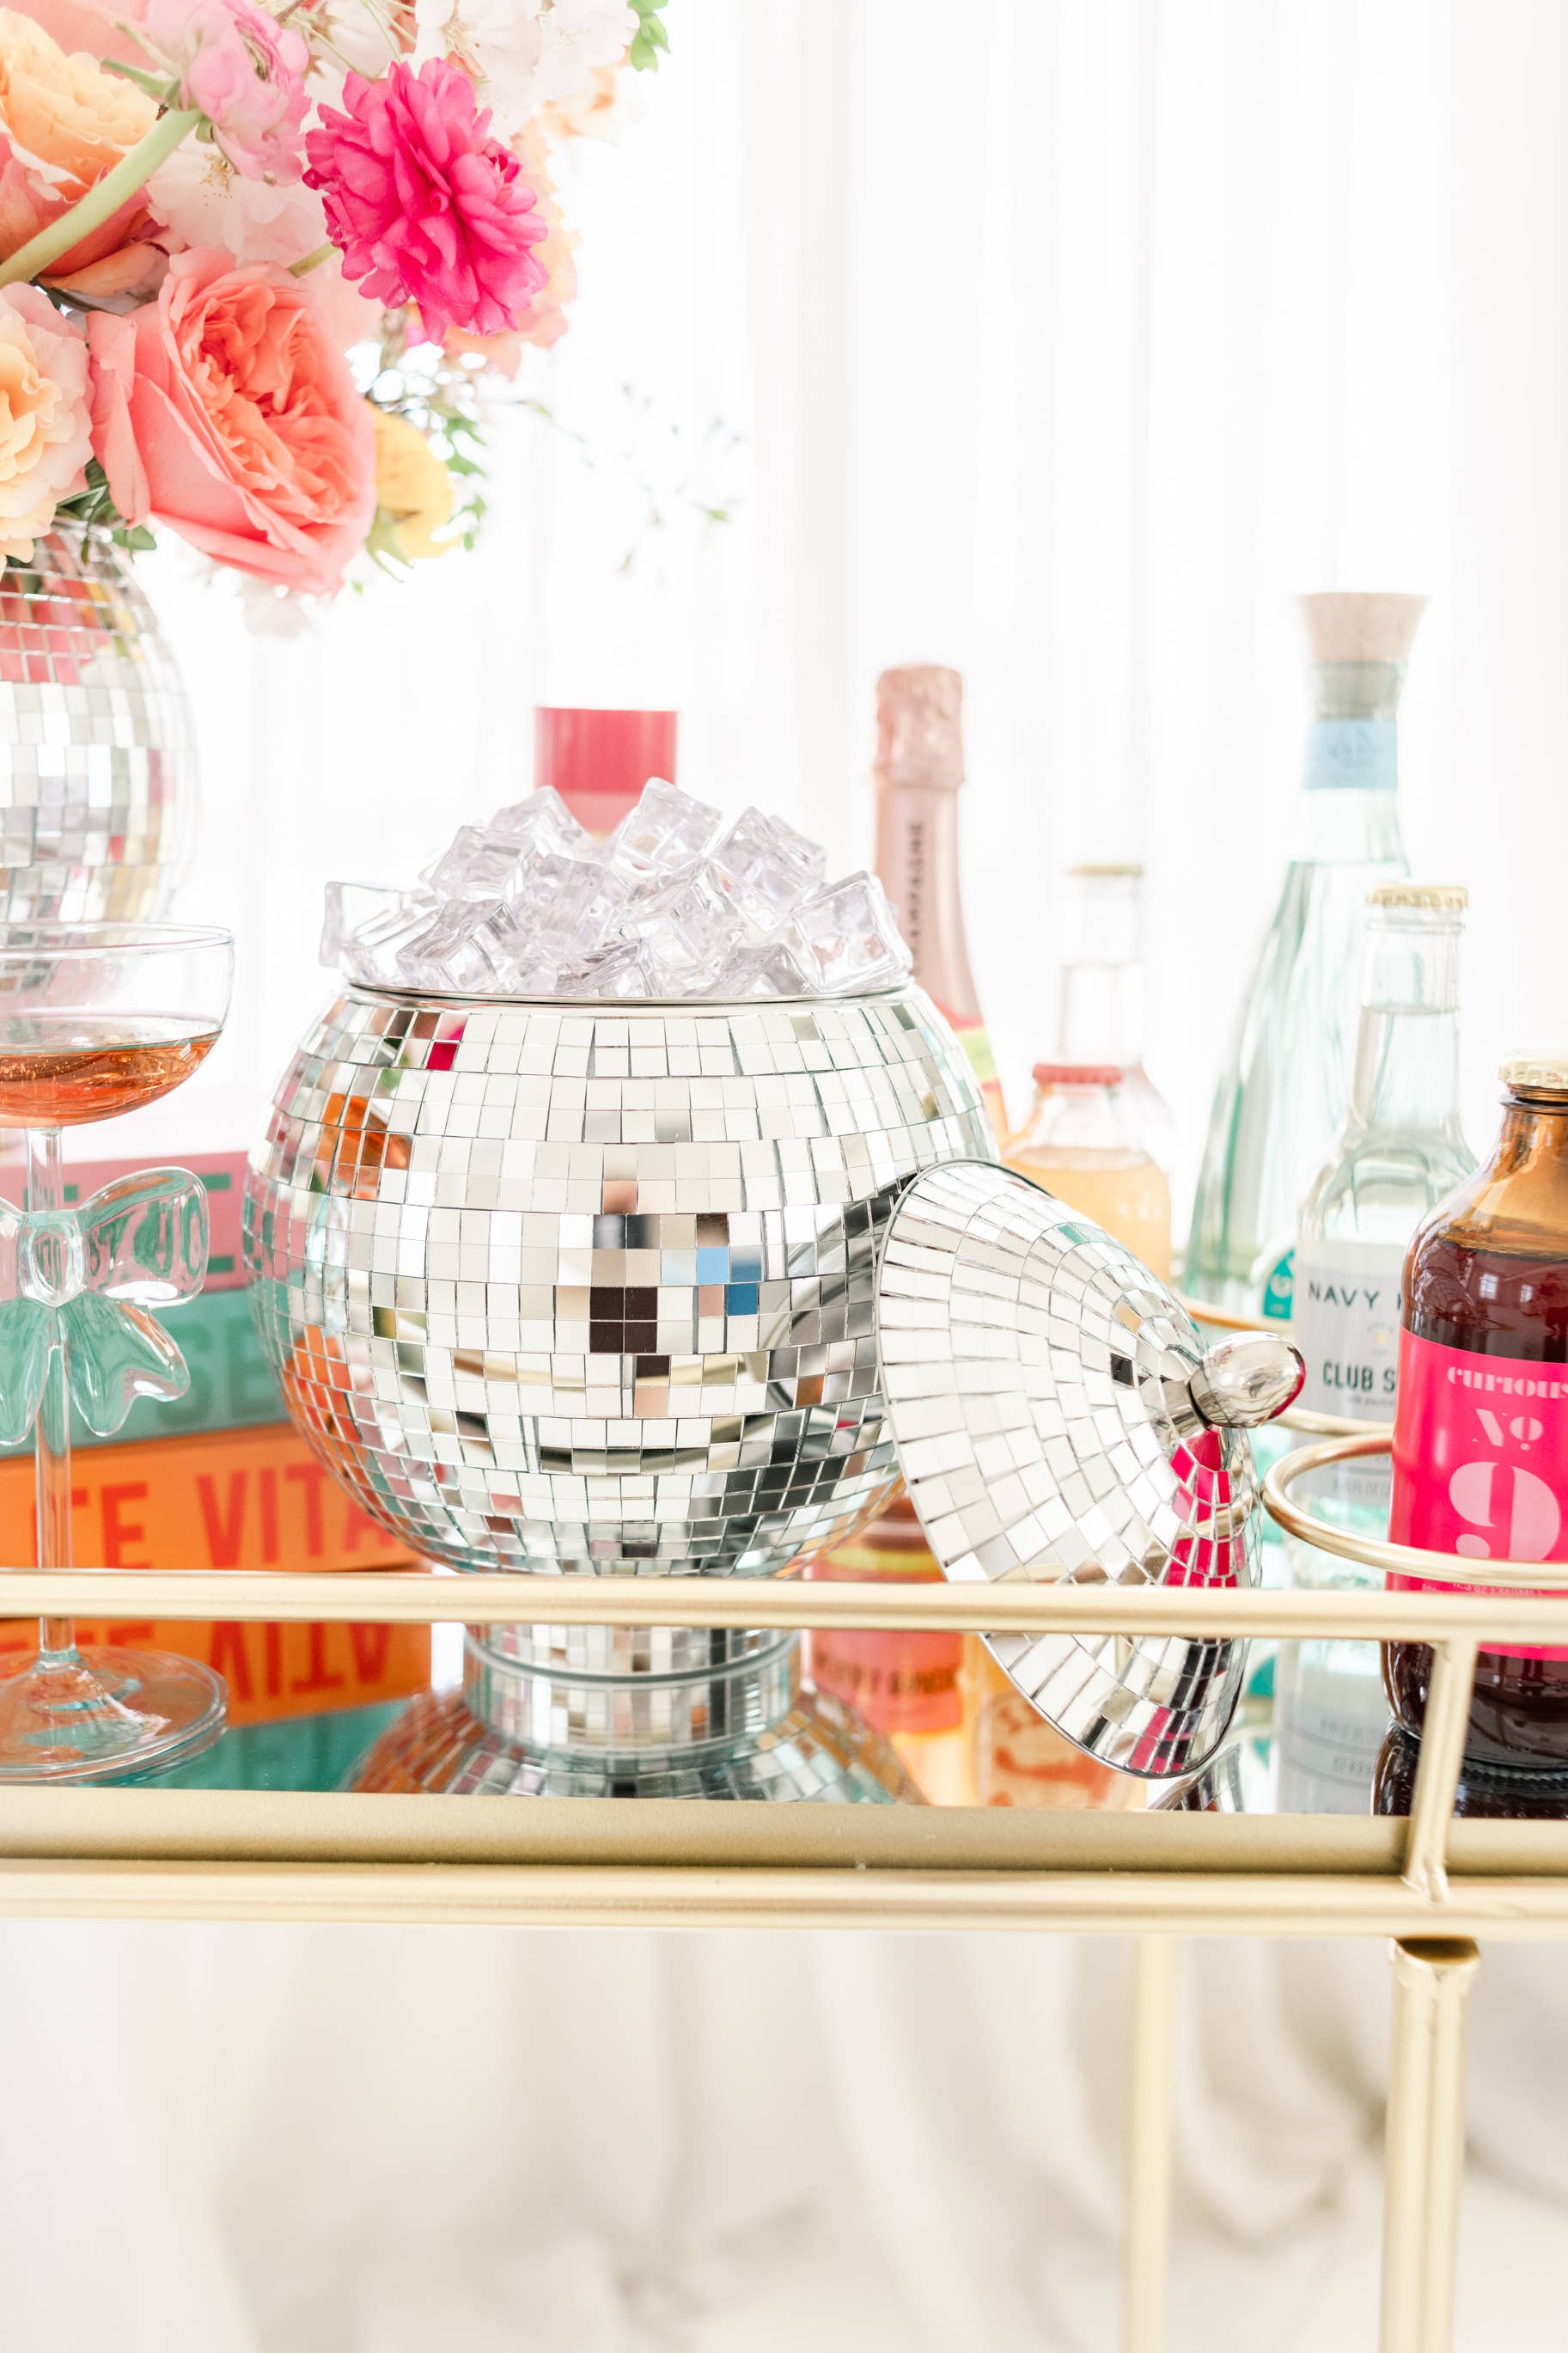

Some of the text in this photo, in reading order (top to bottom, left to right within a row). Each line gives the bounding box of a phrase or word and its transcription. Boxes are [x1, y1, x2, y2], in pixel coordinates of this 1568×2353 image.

[1308, 1280, 1380, 1310] NAVY
[1322, 1360, 1373, 1390] CLUB
[1449, 1461, 1561, 1560] 9
